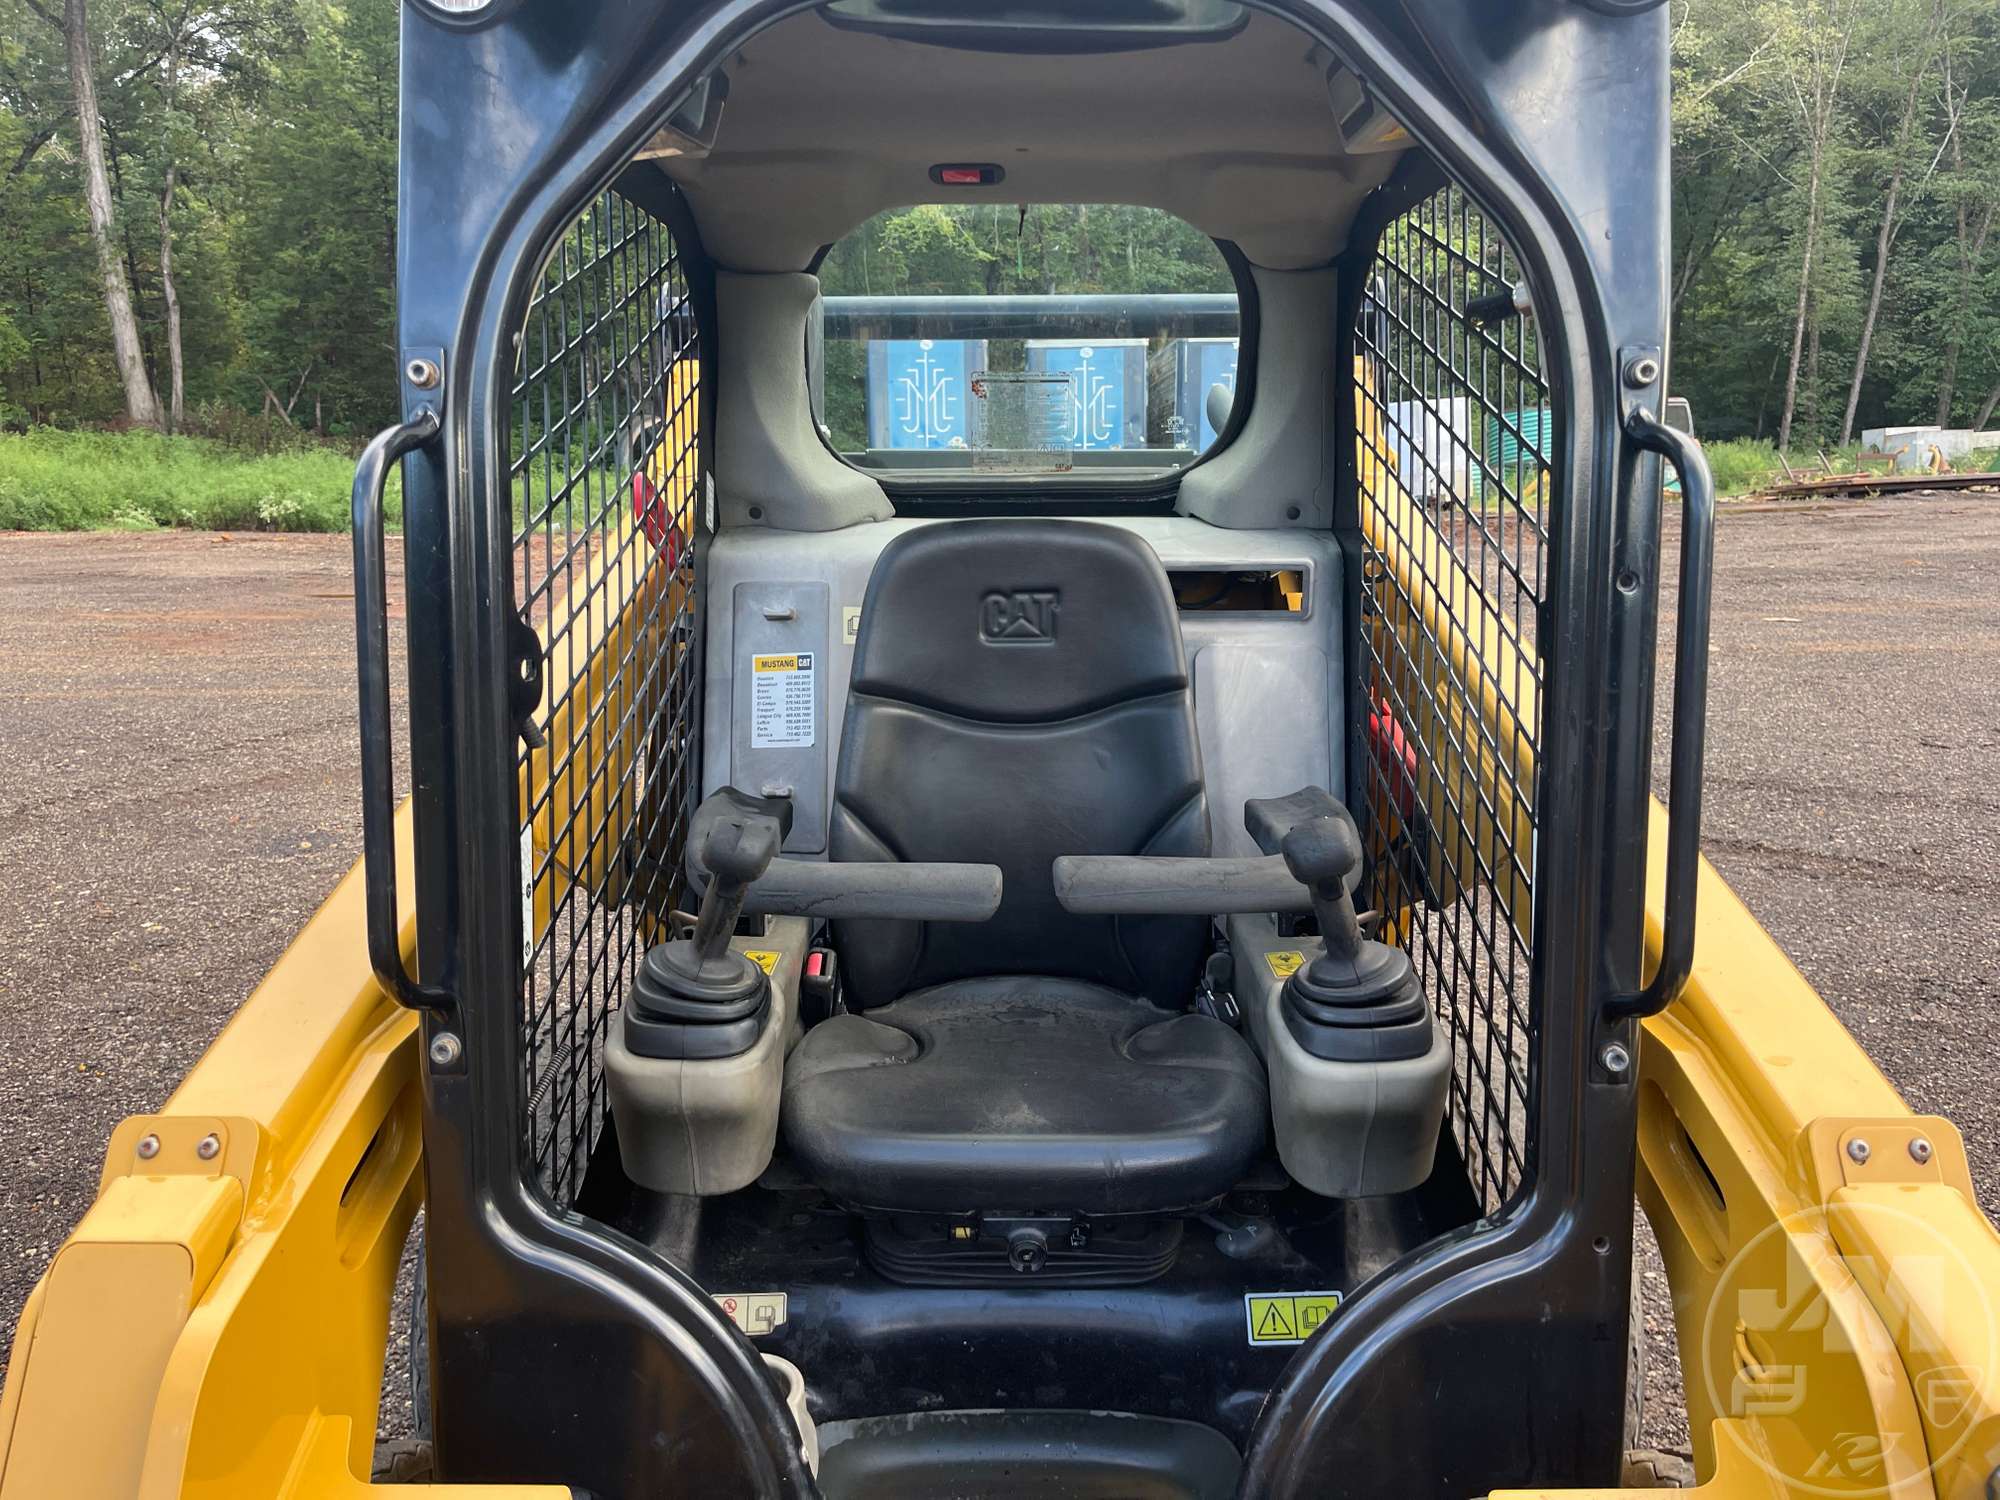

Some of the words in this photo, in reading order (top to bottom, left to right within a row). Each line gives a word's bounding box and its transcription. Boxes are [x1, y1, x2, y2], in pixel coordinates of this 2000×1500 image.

[983, 593, 1057, 641] CAT
[761, 659, 794, 668] MUSTANG
[798, 658, 811, 667] CAT
